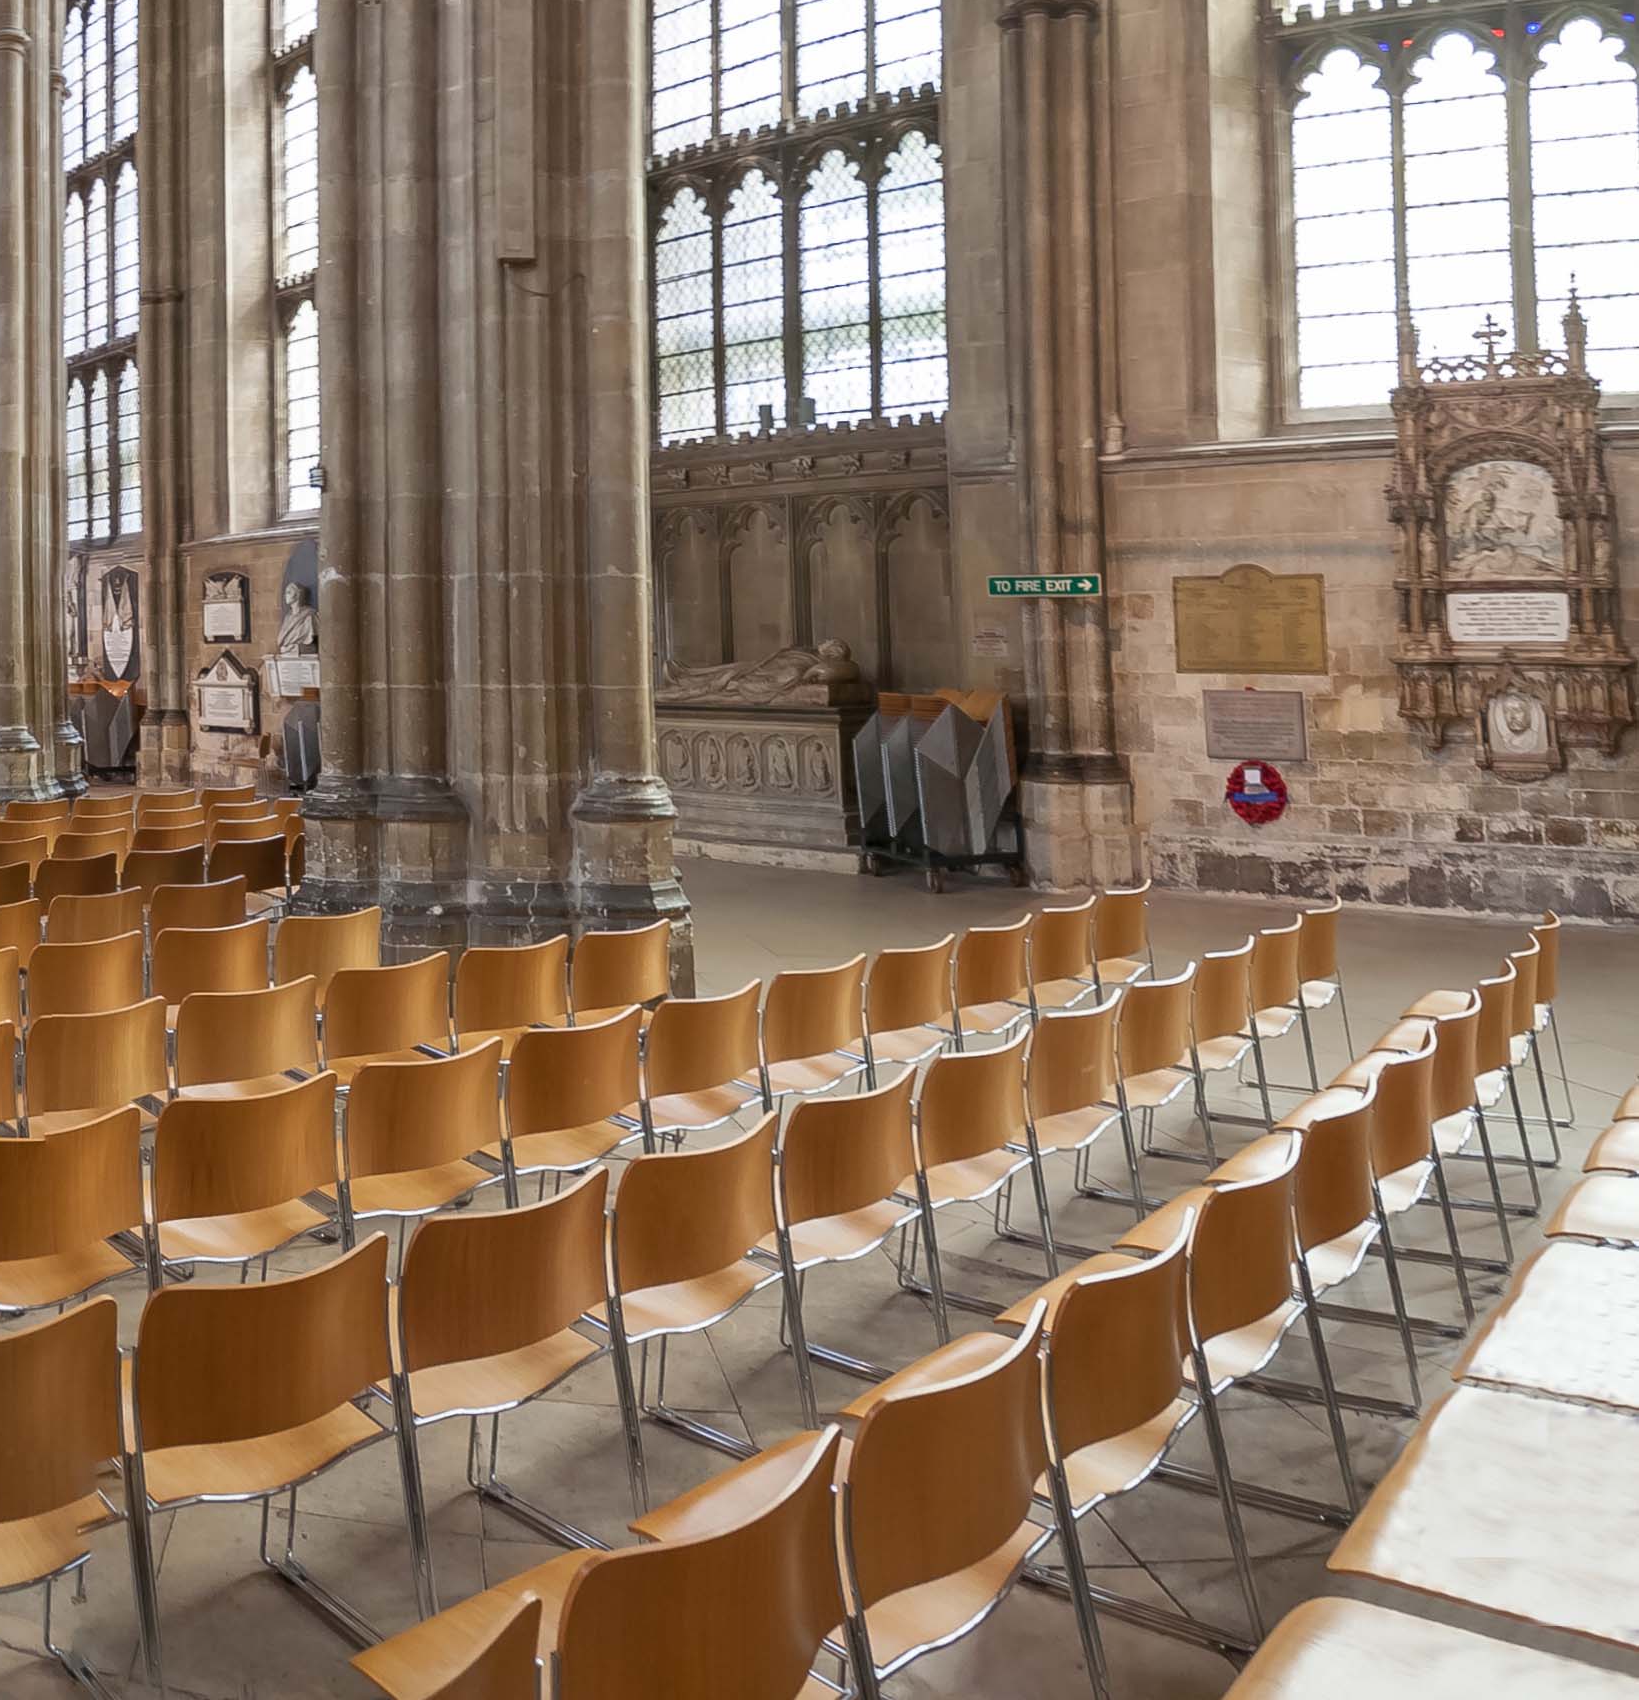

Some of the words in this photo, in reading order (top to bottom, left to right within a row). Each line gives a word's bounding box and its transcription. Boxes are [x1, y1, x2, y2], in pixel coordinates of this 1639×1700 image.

[994, 580, 1011, 592] TO
[1014, 580, 1042, 592] FIRE
[1045, 579, 1073, 592] EXIT
